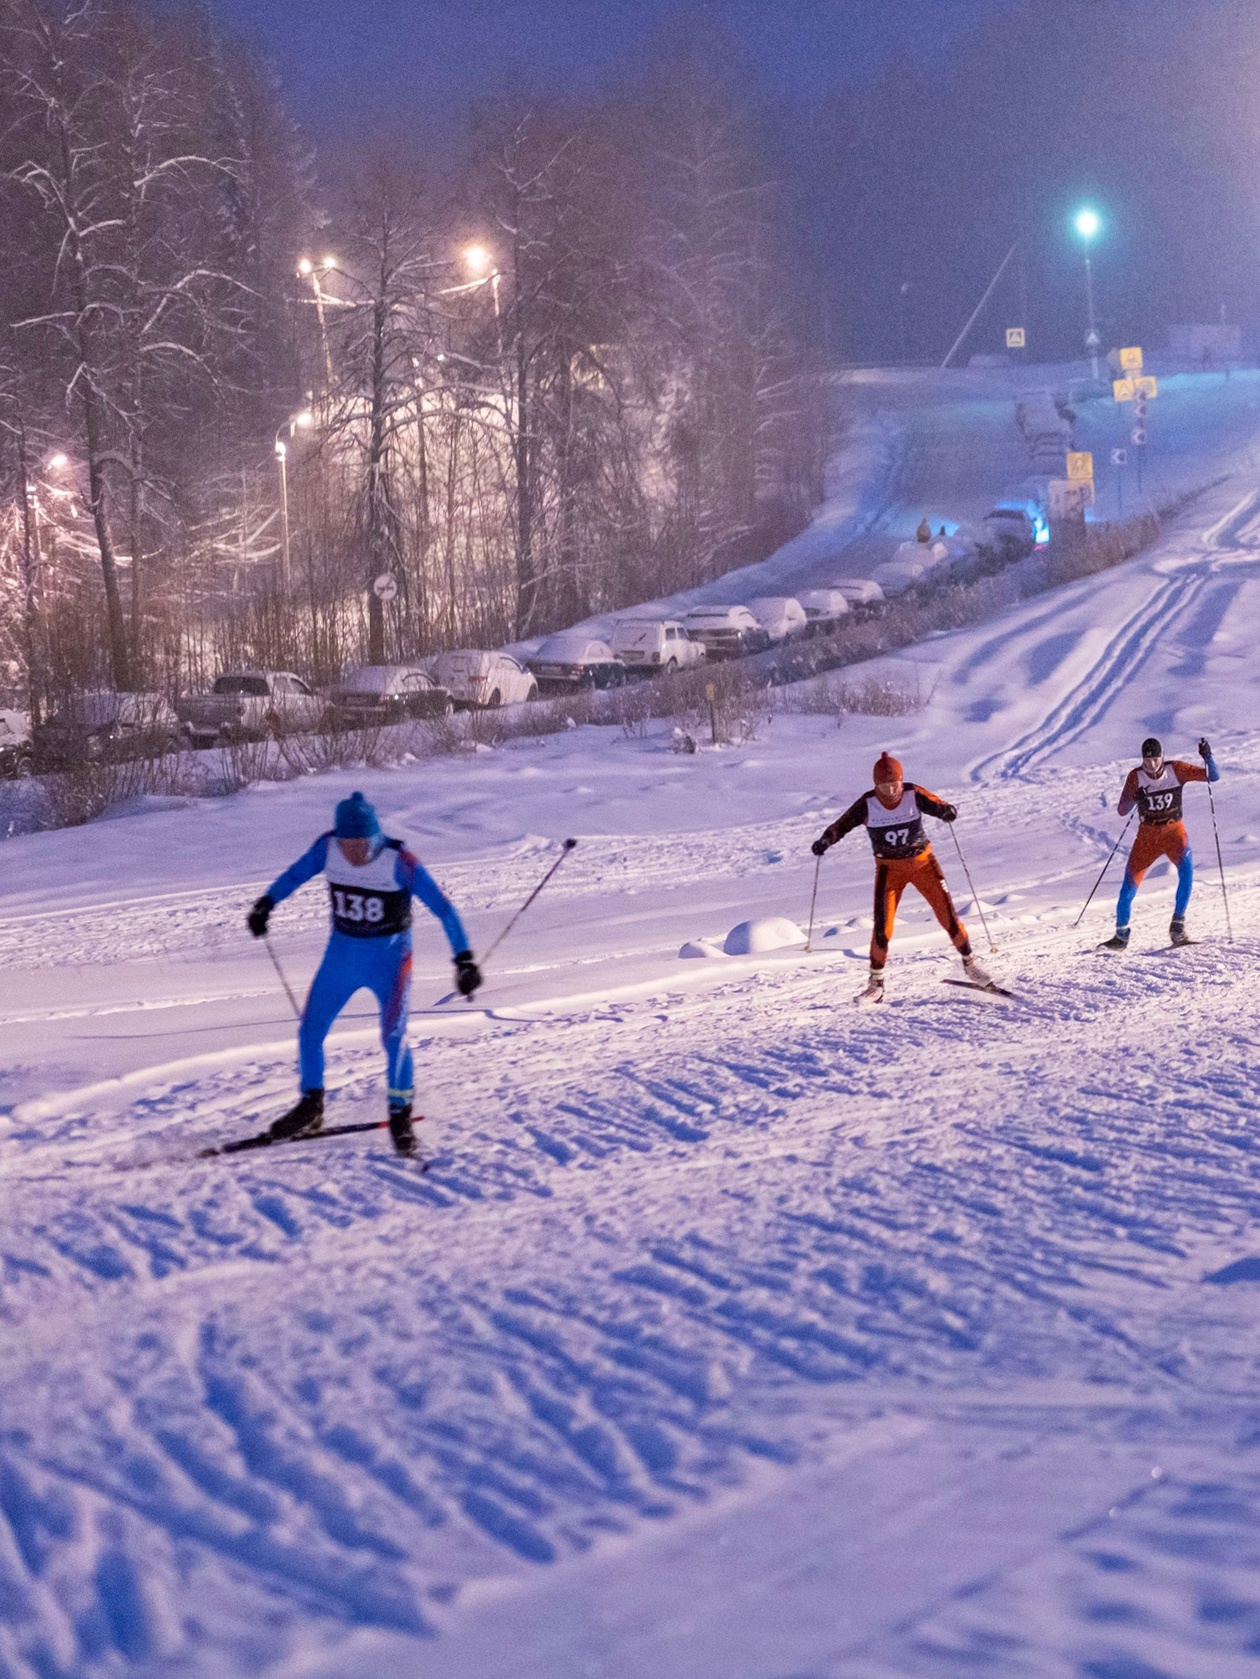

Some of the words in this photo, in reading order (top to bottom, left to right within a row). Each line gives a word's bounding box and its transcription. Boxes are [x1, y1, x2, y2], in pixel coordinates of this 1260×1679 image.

[1147, 792, 1174, 811] 139
[884, 828, 909, 846] 97
[333, 890, 384, 922] 138
